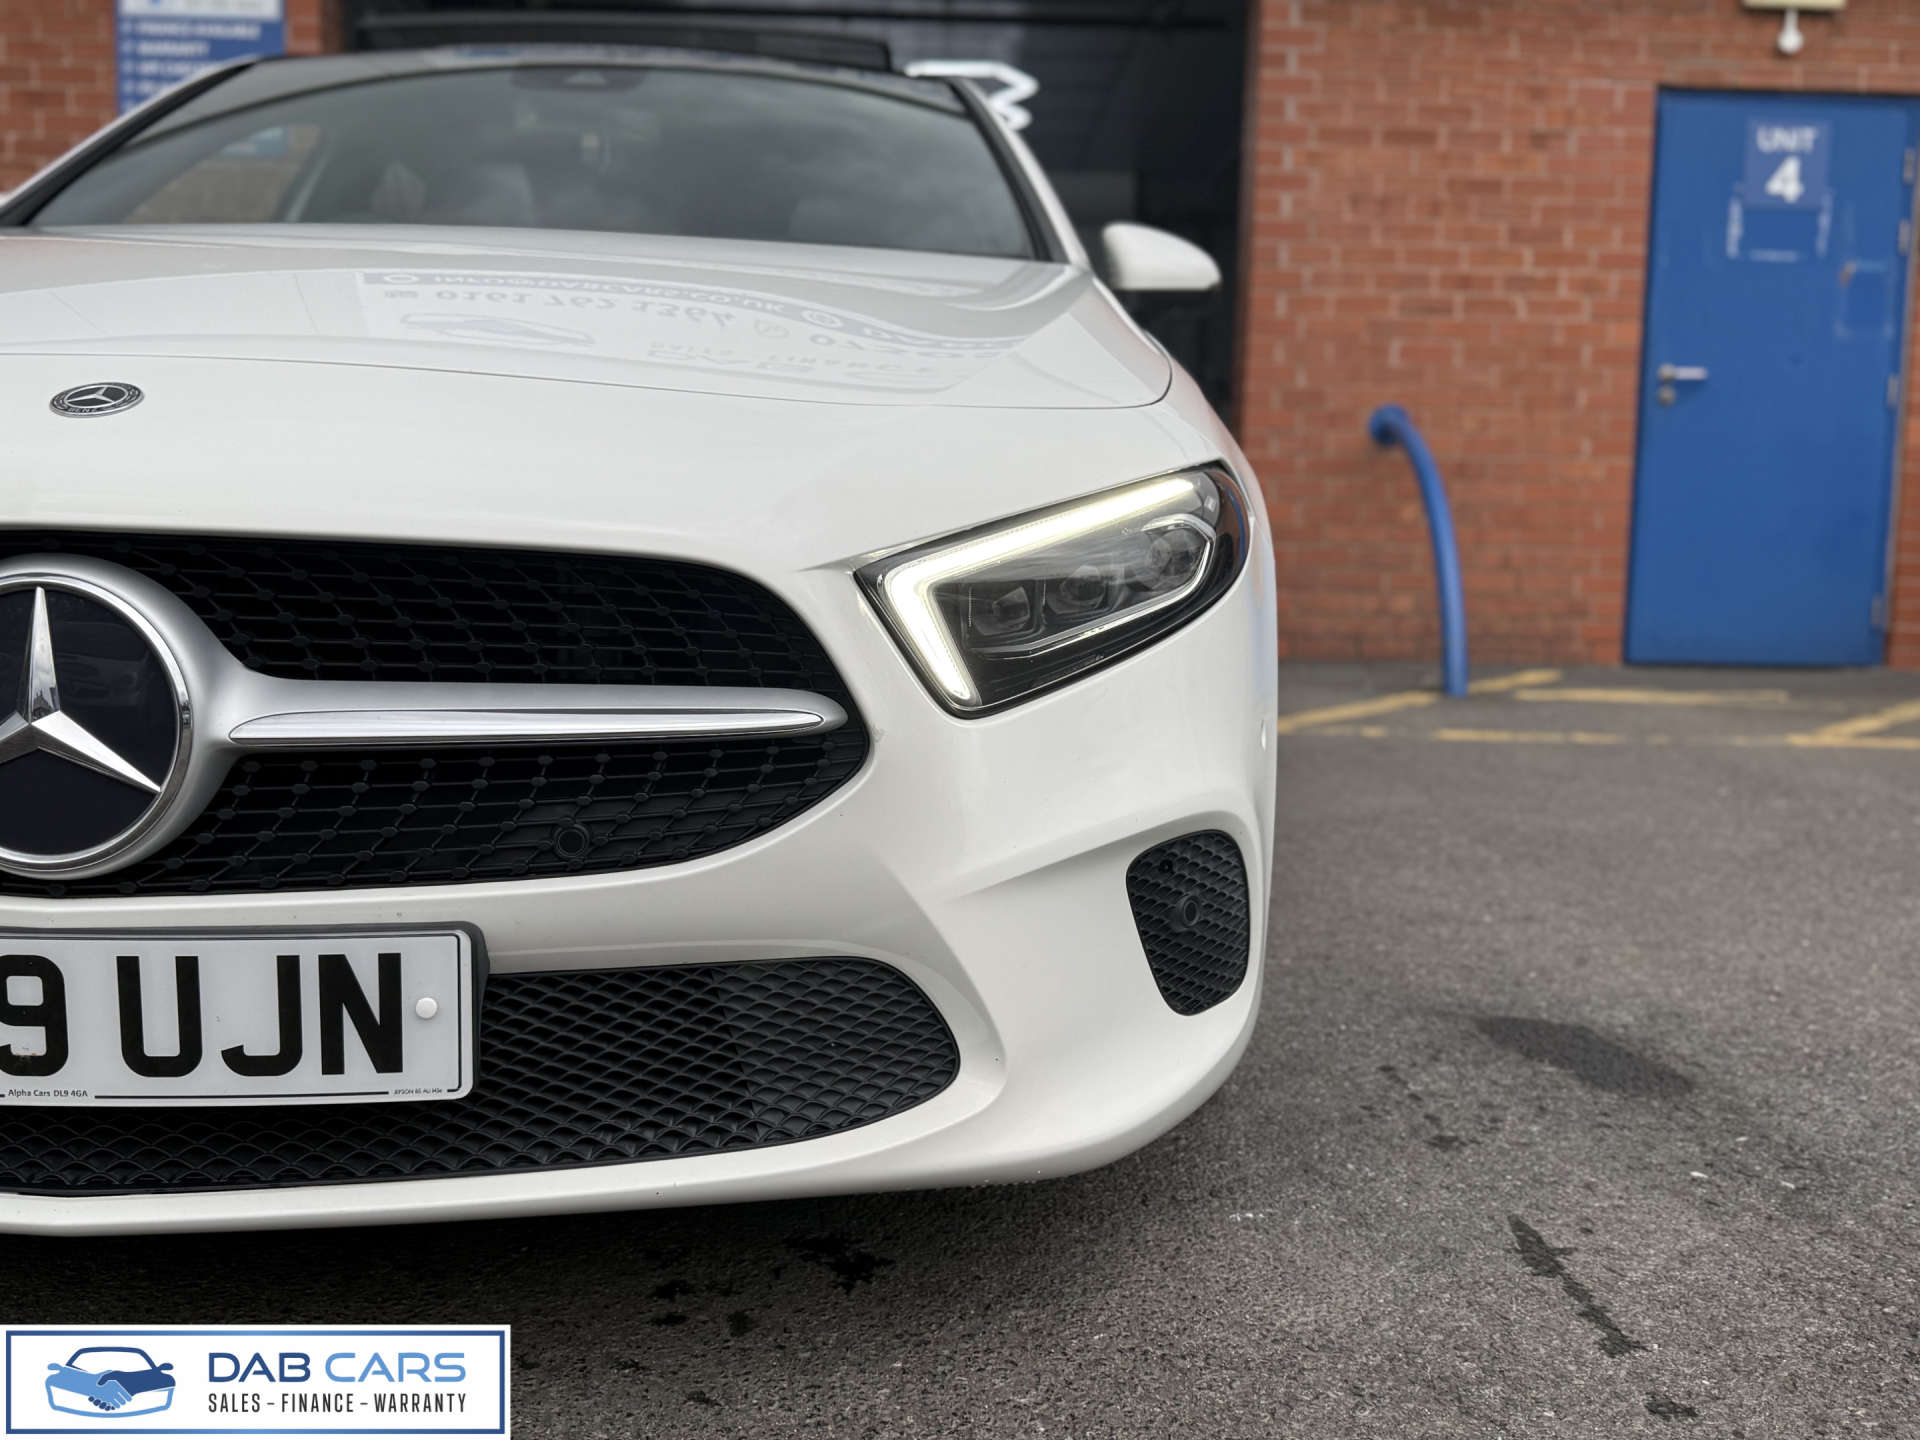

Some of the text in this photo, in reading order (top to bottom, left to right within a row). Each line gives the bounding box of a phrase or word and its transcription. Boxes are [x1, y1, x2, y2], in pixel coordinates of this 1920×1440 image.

[1755, 124, 1819, 154] UNIT
[1765, 155, 1805, 203] 4
[0, 952, 404, 1078] 9 UJN
[8, 1089, 32, 1098] Alpha
[33, 1089, 51, 1097] Cars
